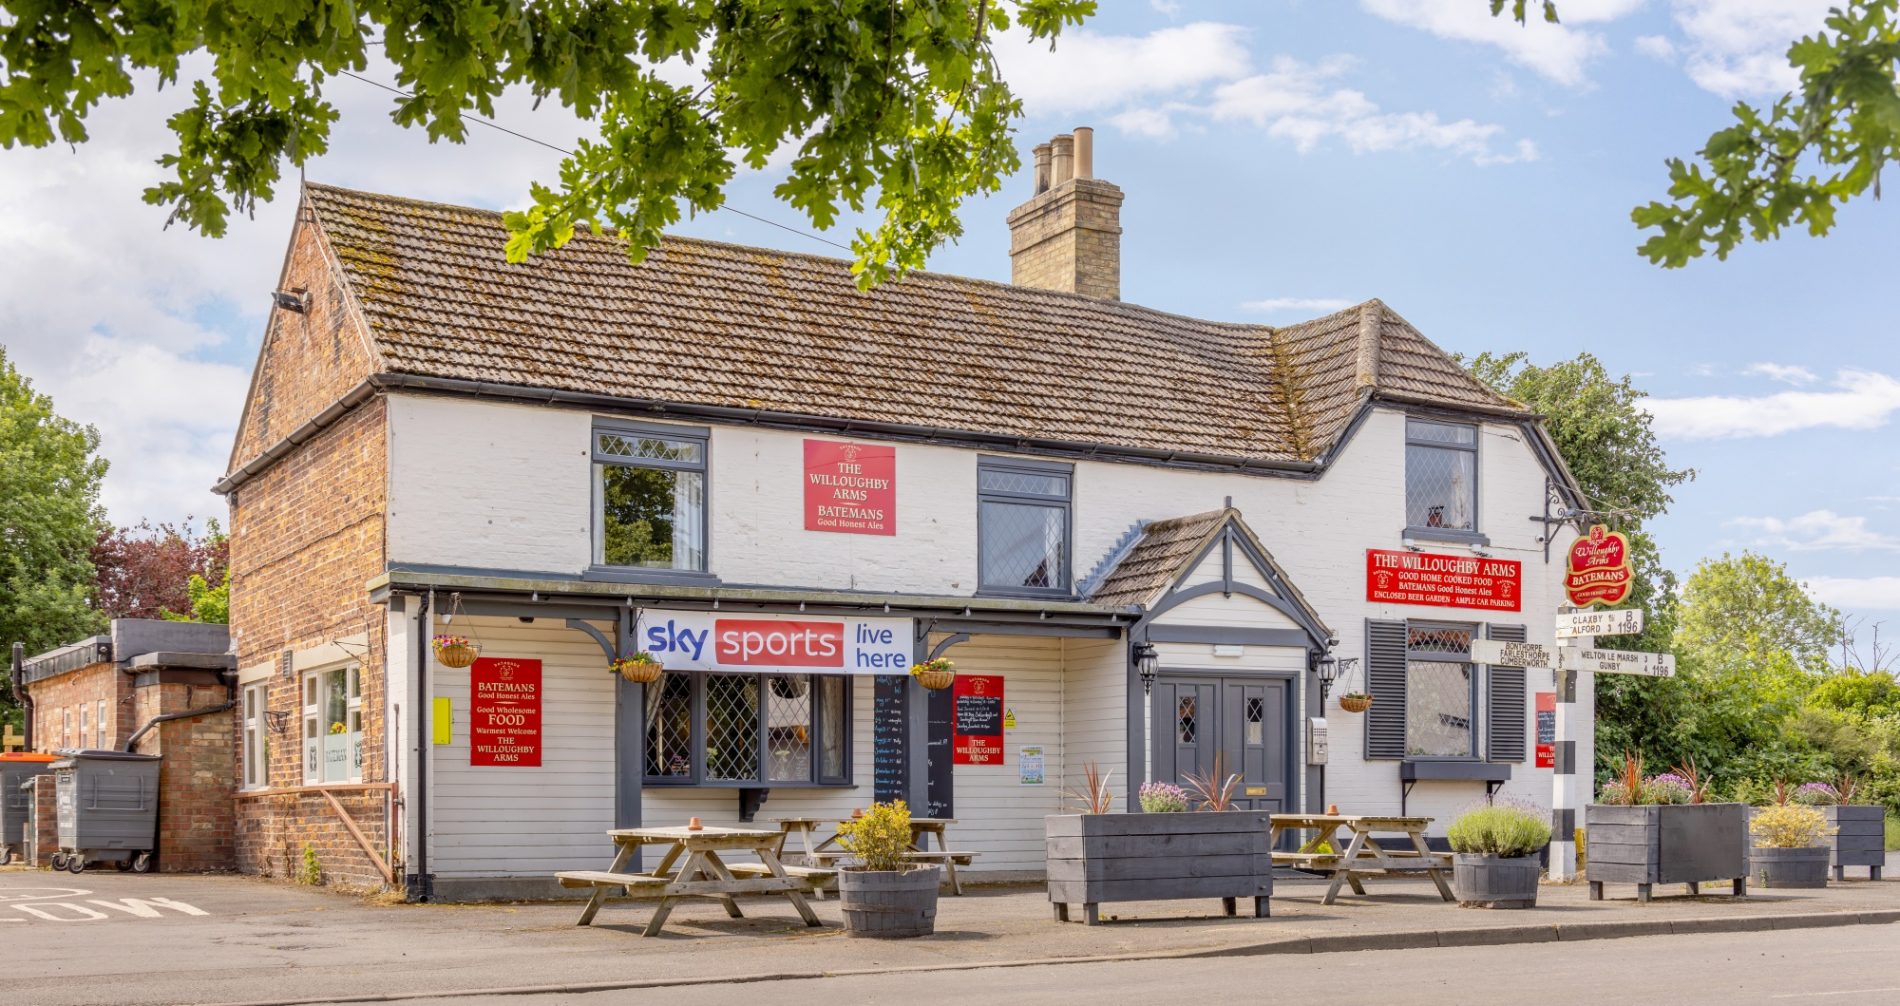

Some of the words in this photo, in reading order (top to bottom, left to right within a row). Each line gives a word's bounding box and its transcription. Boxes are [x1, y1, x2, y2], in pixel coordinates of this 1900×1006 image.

[838, 462, 862, 474] THE
[810, 474, 889, 490] WILLOUGHBY
[833, 488, 867, 500] ARMS
[818, 505, 883, 520] BATEMANS
[818, 519, 836, 527] Good
[840, 520, 865, 528] Honest
[1576, 541, 1620, 557] Willoughby
[1374, 554, 1398, 568] THE
[1402, 556, 1480, 574] WILLOUGHBY
[1483, 563, 1516, 578] ARMS
[1585, 556, 1609, 566] Arms
[1398, 572, 1419, 580] GOOD
[1421, 573, 1442, 582] HOME
[1444, 575, 1472, 585] COOKED
[1473, 577, 1492, 586] FOOD
[1572, 571, 1624, 585] BATEMANS
[1399, 582, 1436, 592] BATEMANS
[1437, 584, 1453, 593] Good
[1455, 586, 1477, 595] Honest
[1479, 588, 1492, 596] Ales
[1374, 591, 1406, 600] ENCLOSED
[1426, 594, 1450, 603] GARDEN
[1455, 597, 1476, 605] AMPLE
[1490, 599, 1515, 607] PARKING
[1572, 615, 1603, 624] CLAXBY
[1626, 611, 1633, 621] B
[1572, 625, 1600, 634] ALFORD
[1618, 621, 1638, 633] 1196
[856, 624, 893, 644] live
[647, 619, 709, 661] sky
[722, 628, 836, 662] sports
[1506, 642, 1542, 652] BONTHORPE
[856, 647, 906, 668] here
[1501, 650, 1550, 660] FARLESTHORPE
[1581, 651, 1606, 660] WELTON
[1617, 654, 1638, 662] MARSH
[1657, 653, 1663, 664] B
[1501, 657, 1548, 668] CUMBERWORTH
[1600, 662, 1620, 670] GUNBY
[1652, 665, 1669, 676] 1196
[478, 682, 535, 692] BATEMANS
[488, 714, 525, 726] FOOD
[478, 745, 534, 753] WILLOUGHBY
